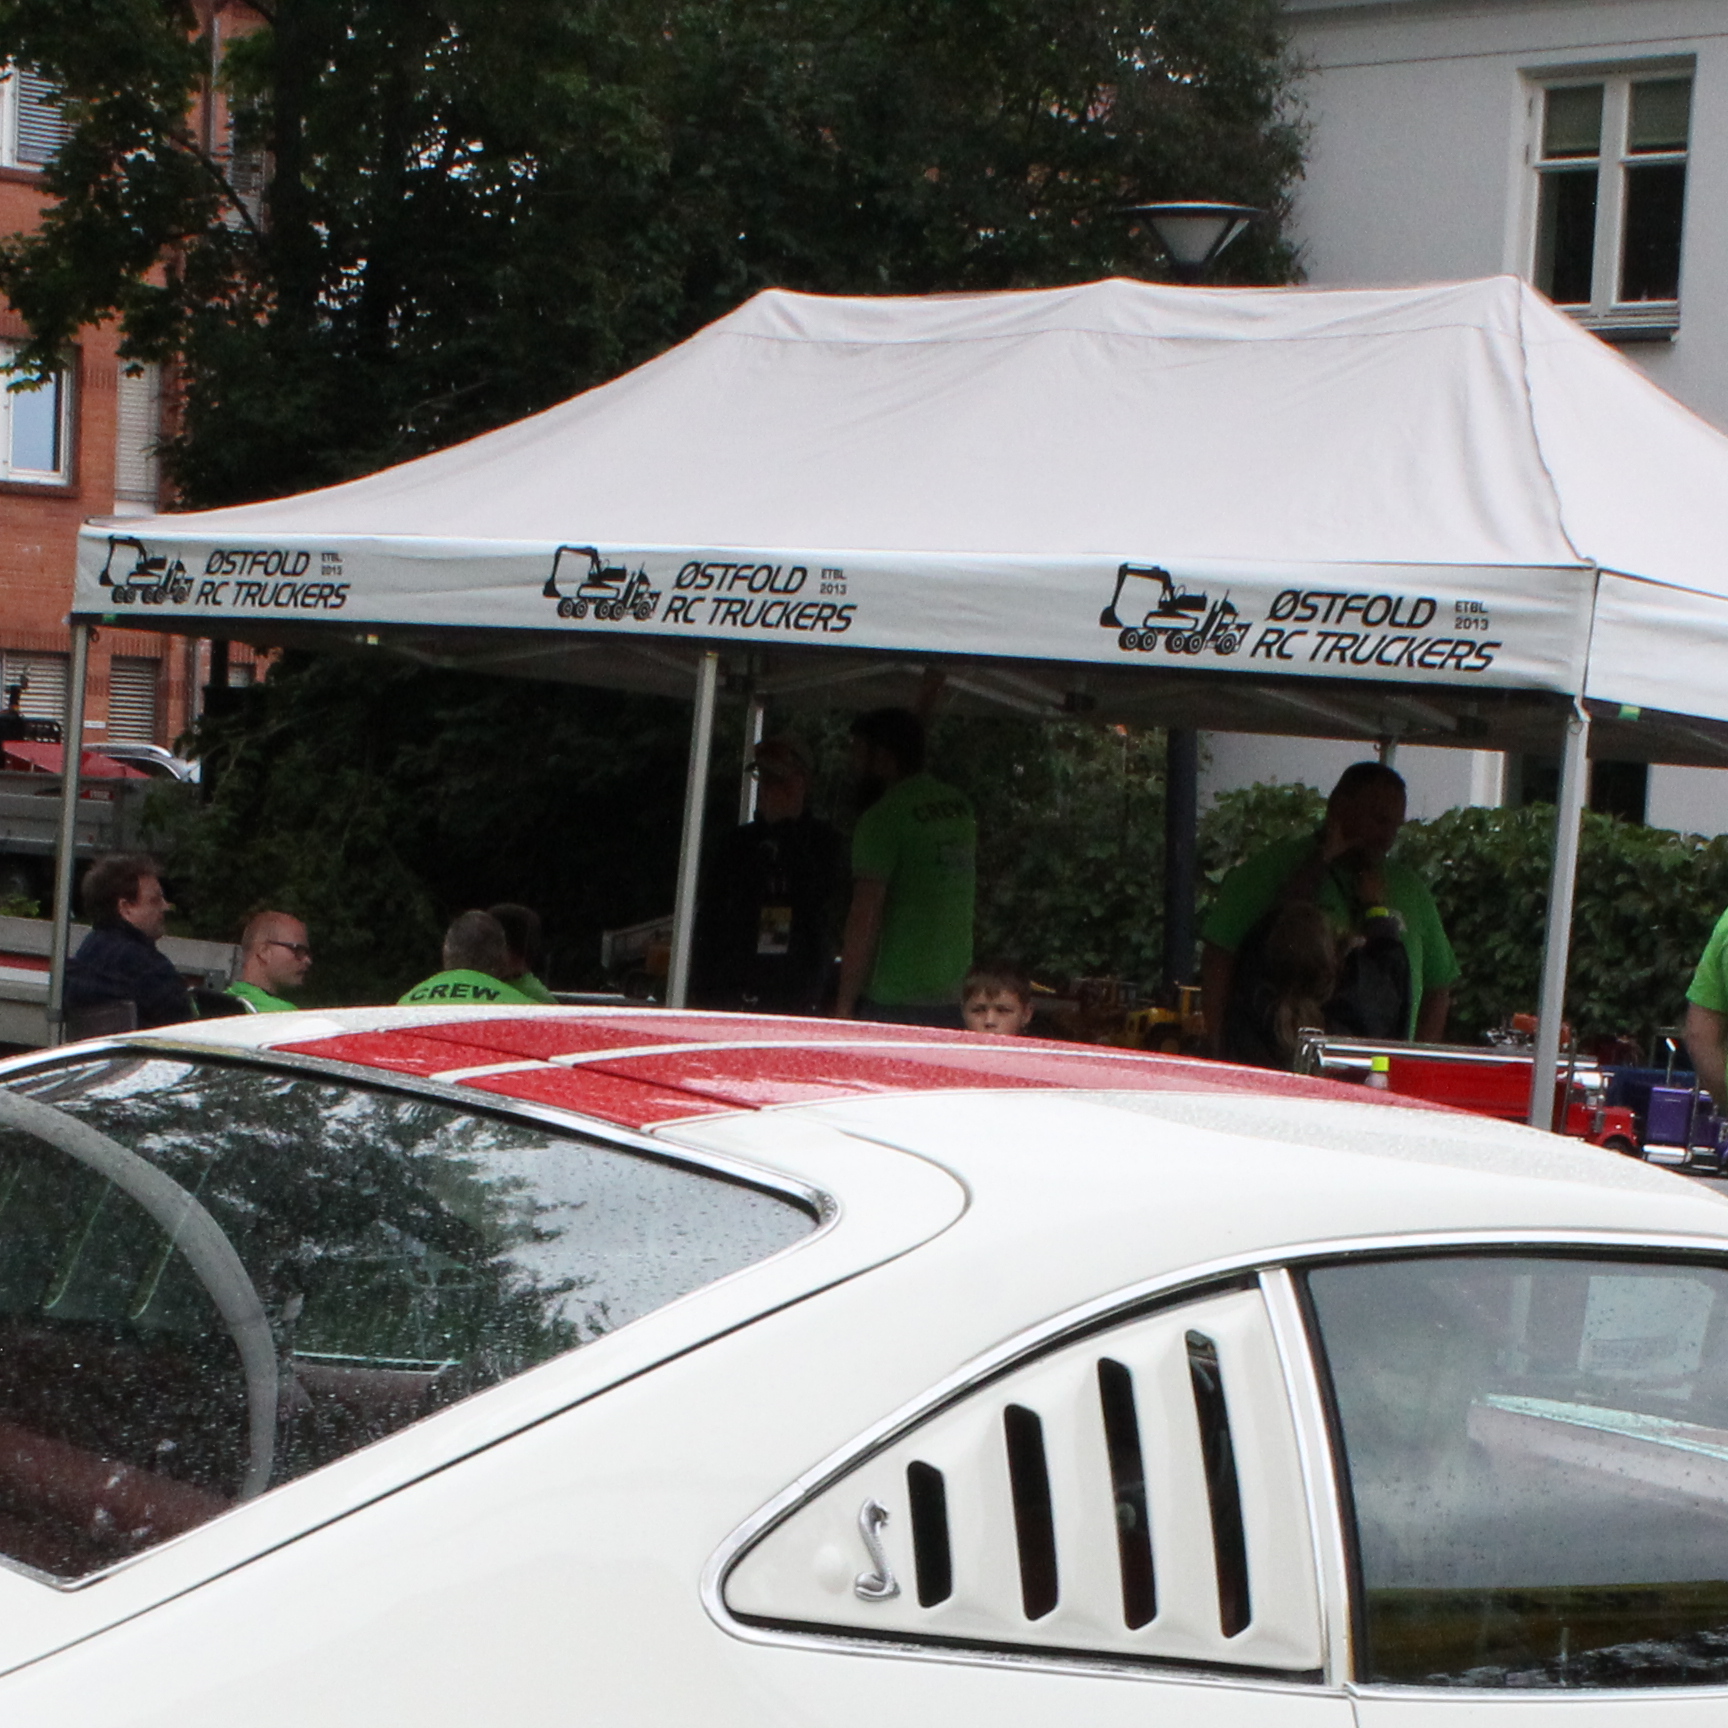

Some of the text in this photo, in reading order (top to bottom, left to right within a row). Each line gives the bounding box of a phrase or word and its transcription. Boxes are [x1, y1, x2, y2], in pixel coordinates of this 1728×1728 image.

[204, 549, 311, 577] ØSTFOLD
[673, 560, 808, 594] ØSTFOLD
[196, 579, 352, 609] RC TRUCKERS
[820, 583, 847, 595] 2013
[661, 595, 858, 632] RC TRUCKERS
[1265, 589, 1438, 629] ØSTFOLD
[1454, 601, 1488, 614] ETBL
[1454, 617, 1489, 631] 2013
[1250, 628, 1503, 672] RC TRUCKERS
[410, 982, 501, 1001] CREW
